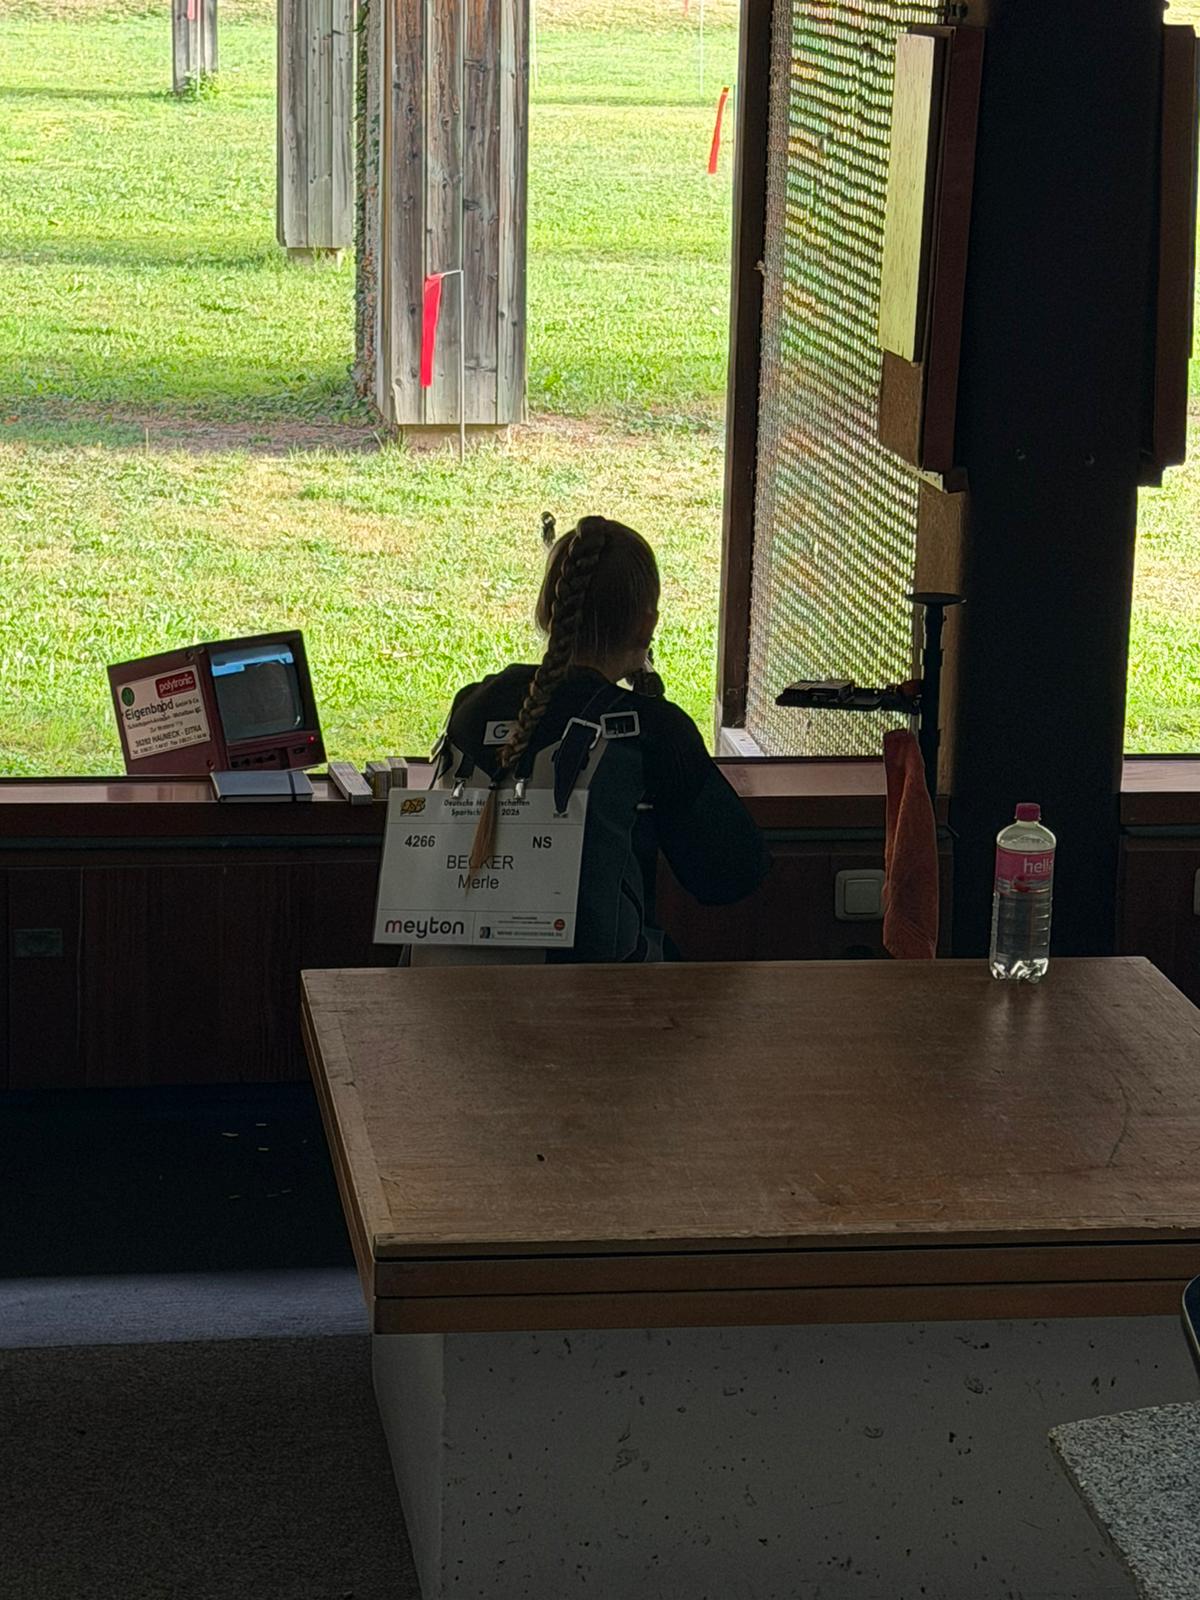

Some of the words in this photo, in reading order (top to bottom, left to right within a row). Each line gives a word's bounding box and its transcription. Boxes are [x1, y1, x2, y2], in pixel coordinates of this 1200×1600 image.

[159, 674, 194, 693] polytronic
[404, 835, 436, 848] 4266
[532, 836, 552, 849] NS
[458, 874, 500, 889] Merle
[384, 916, 465, 939] meyton
